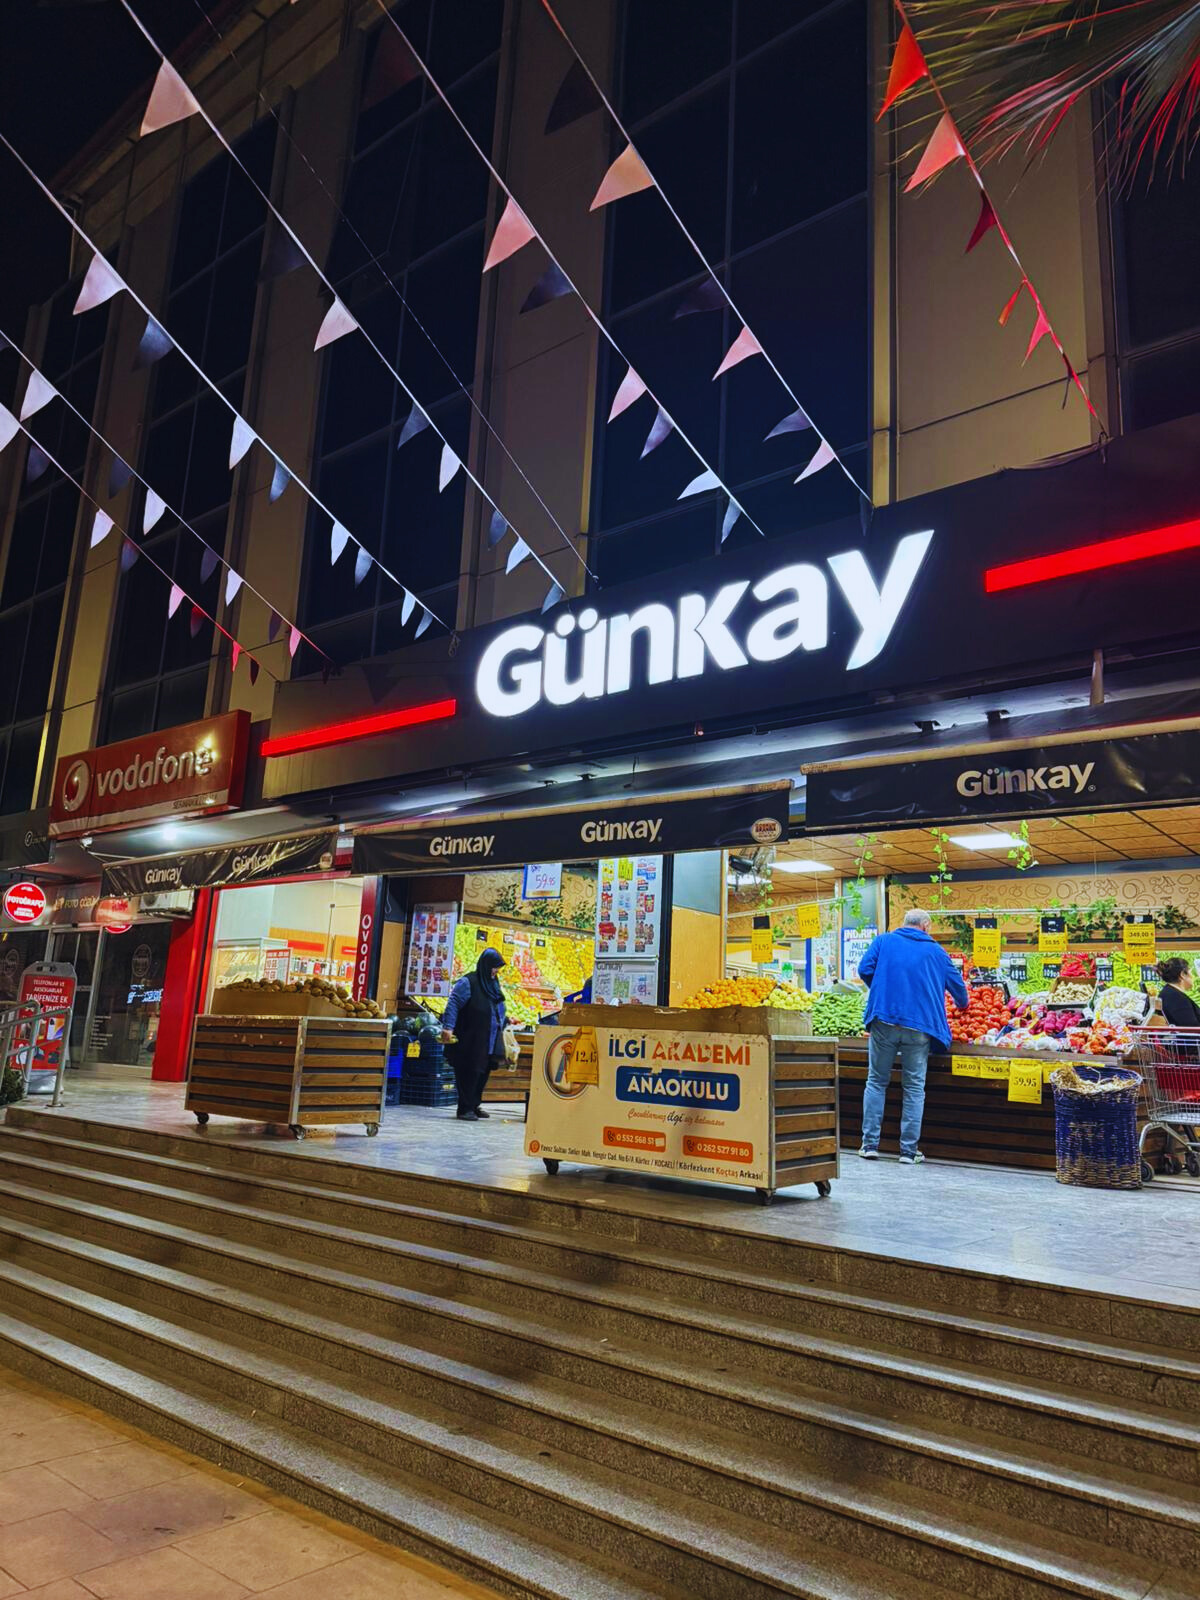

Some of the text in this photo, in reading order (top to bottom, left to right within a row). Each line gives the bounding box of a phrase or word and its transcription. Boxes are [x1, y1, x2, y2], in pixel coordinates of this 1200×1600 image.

[476, 529, 934, 717] Günkay
[97, 746, 212, 797] vodafone
[956, 762, 1096, 797] Günkay
[580, 818, 662, 843] Günkay
[429, 835, 495, 856] Günkay
[145, 865, 183, 884] Günkay
[26, 993, 69, 1003] TARİFENİZE EK
[608, 1034, 751, 1066] İLGİ AKADEMİ
[627, 1075, 729, 1101] ANAOKULU
[703, 1144, 716, 1153] 262
[716, 1145, 730, 1155] 527
[730, 1147, 738, 1156] 91
[738, 1148, 750, 1157] 80
[679, 1161, 715, 1174] Körfezkent
[715, 1167, 738, 1178] Koçtaş
